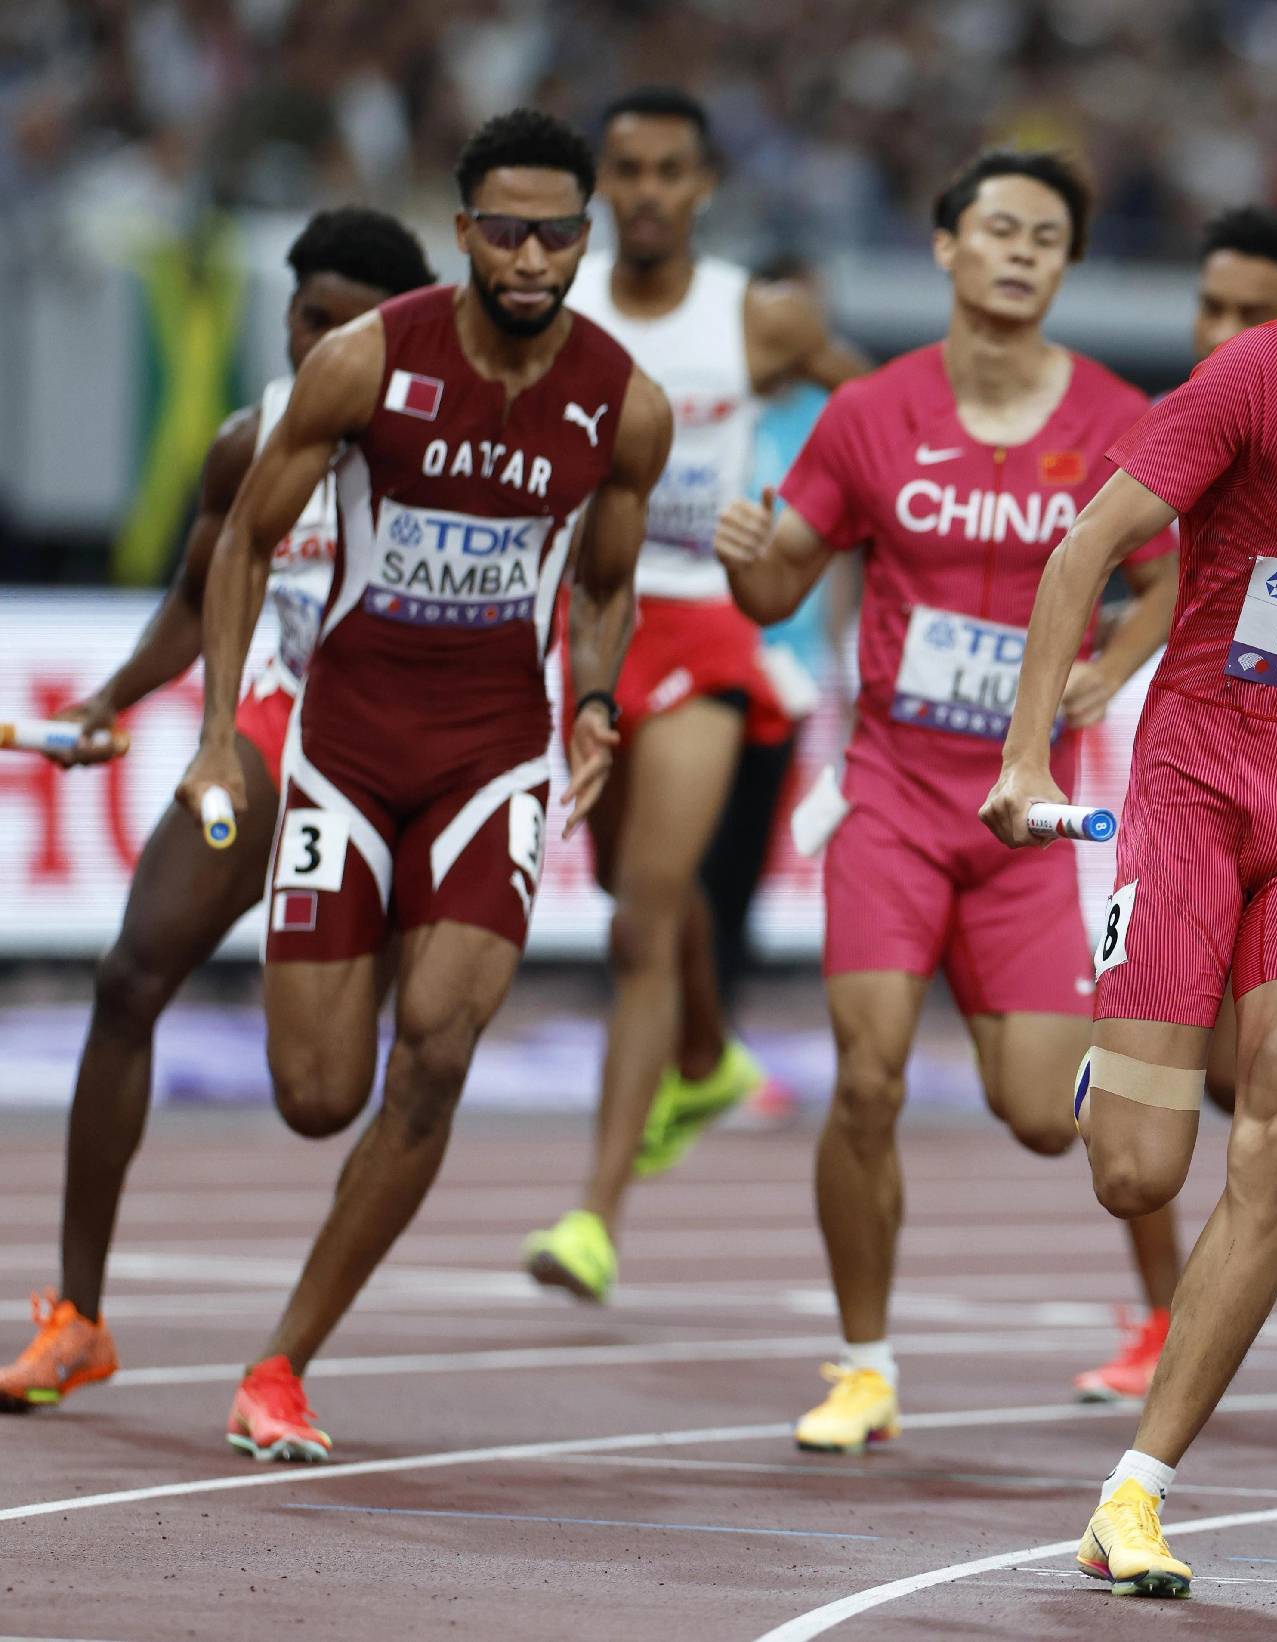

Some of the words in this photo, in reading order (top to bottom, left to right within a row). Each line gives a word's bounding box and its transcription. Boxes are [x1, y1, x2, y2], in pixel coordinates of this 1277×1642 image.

[895, 479, 1079, 544] CHINA
[427, 517, 533, 557] TDK
[382, 551, 528, 596] SAMBA
[964, 622, 1028, 664] TD
[294, 826, 322, 875] 3
[1102, 903, 1121, 961] 8
